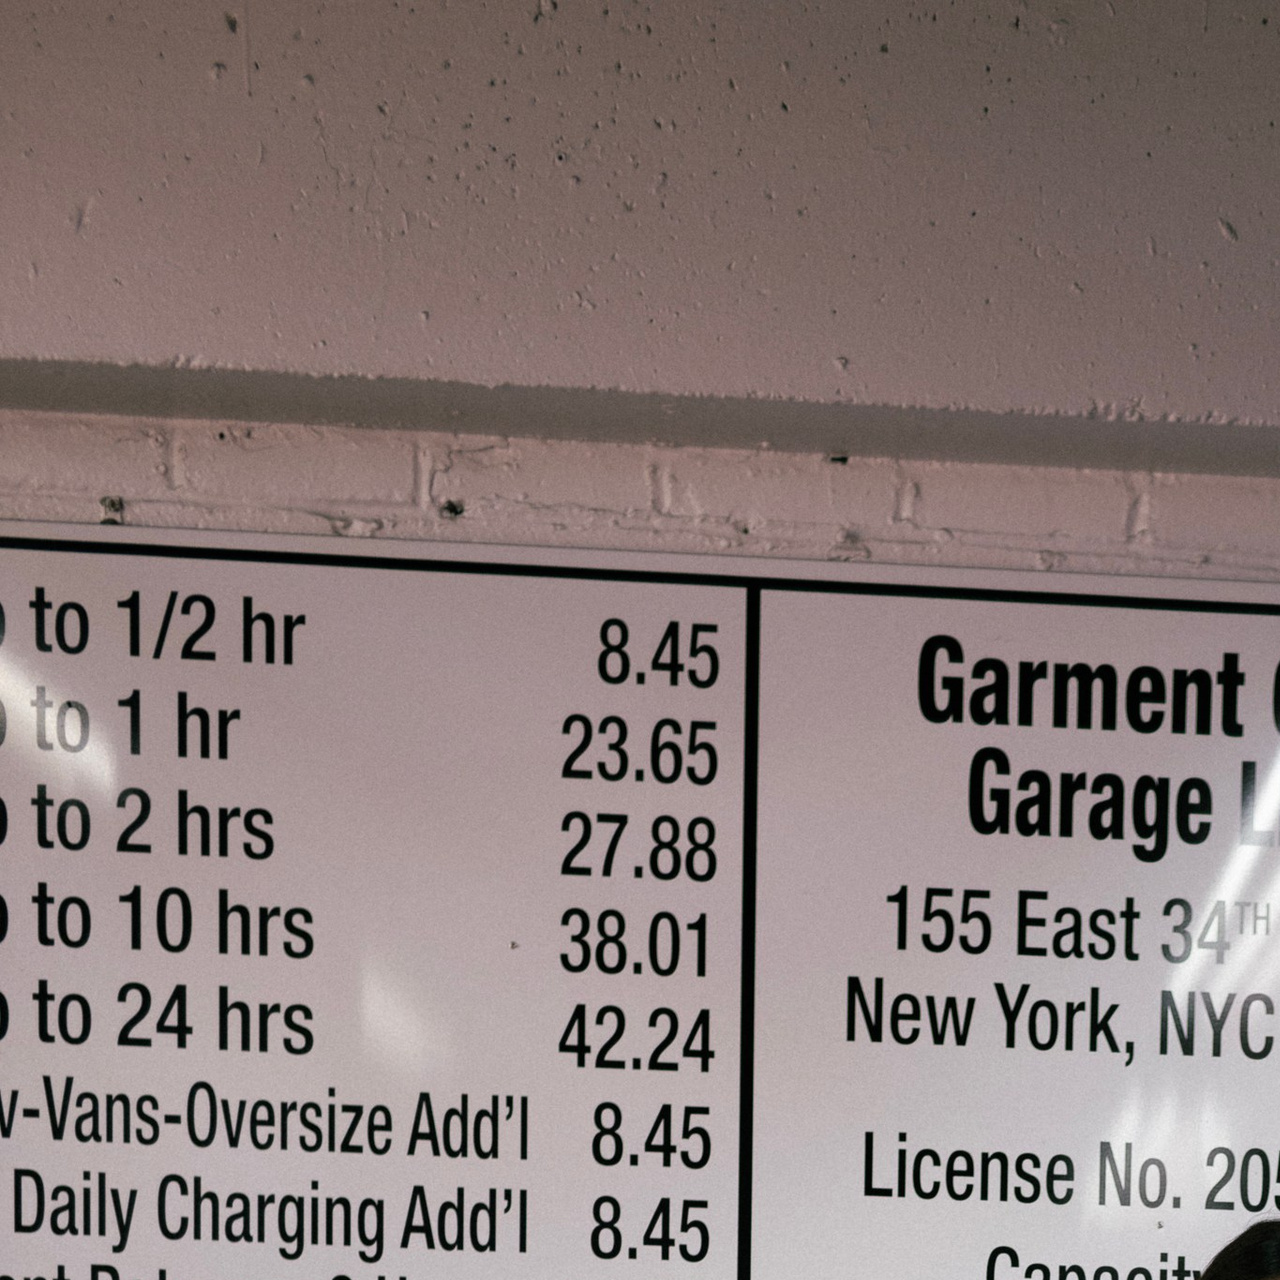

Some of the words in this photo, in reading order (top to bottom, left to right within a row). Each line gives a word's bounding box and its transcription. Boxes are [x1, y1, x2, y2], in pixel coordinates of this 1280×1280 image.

[29, 586, 89, 655] to
[117, 590, 216, 661] 1/2
[243, 596, 306, 665] hr
[598, 618, 719, 689] 8.45
[918, 634, 1245, 737] Garment
[31, 686, 90, 753] to
[117, 688, 141, 756] 1
[177, 690, 241, 761] hr
[562, 713, 718, 786] 23.65
[31, 784, 91, 851] to
[116, 787, 151, 853] 2
[178, 789, 274, 860] hrs
[561, 811, 717, 882] 27.88
[968, 746, 1212, 863] Garage
[32, 882, 91, 949] to
[119, 885, 192, 953] 10
[219, 888, 314, 959] hrs
[560, 907, 707, 977] 38.01
[886, 885, 992, 955] 155
[1017, 890, 1140, 961] East
[32, 979, 92, 1045] to
[117, 982, 193, 1049] 24
[219, 985, 314, 1055] hrs
[558, 1004, 715, 1073] 42.24
[846, 976, 976, 1046] New
[994, 982, 1134, 1066] York,
[1160, 990, 1274, 1060] NYC
[407, 1092, 528, 1160] Add'l
[592, 1102, 711, 1170] 8.45
[864, 1131, 1074, 1205] License
[1099, 1142, 1180, 1208] No.
[14, 1168, 137, 1253] Daily
[157, 1174, 384, 1264] Charging
[400, 1185, 527, 1253] Add'l
[590, 1195, 709, 1263] 8.45
